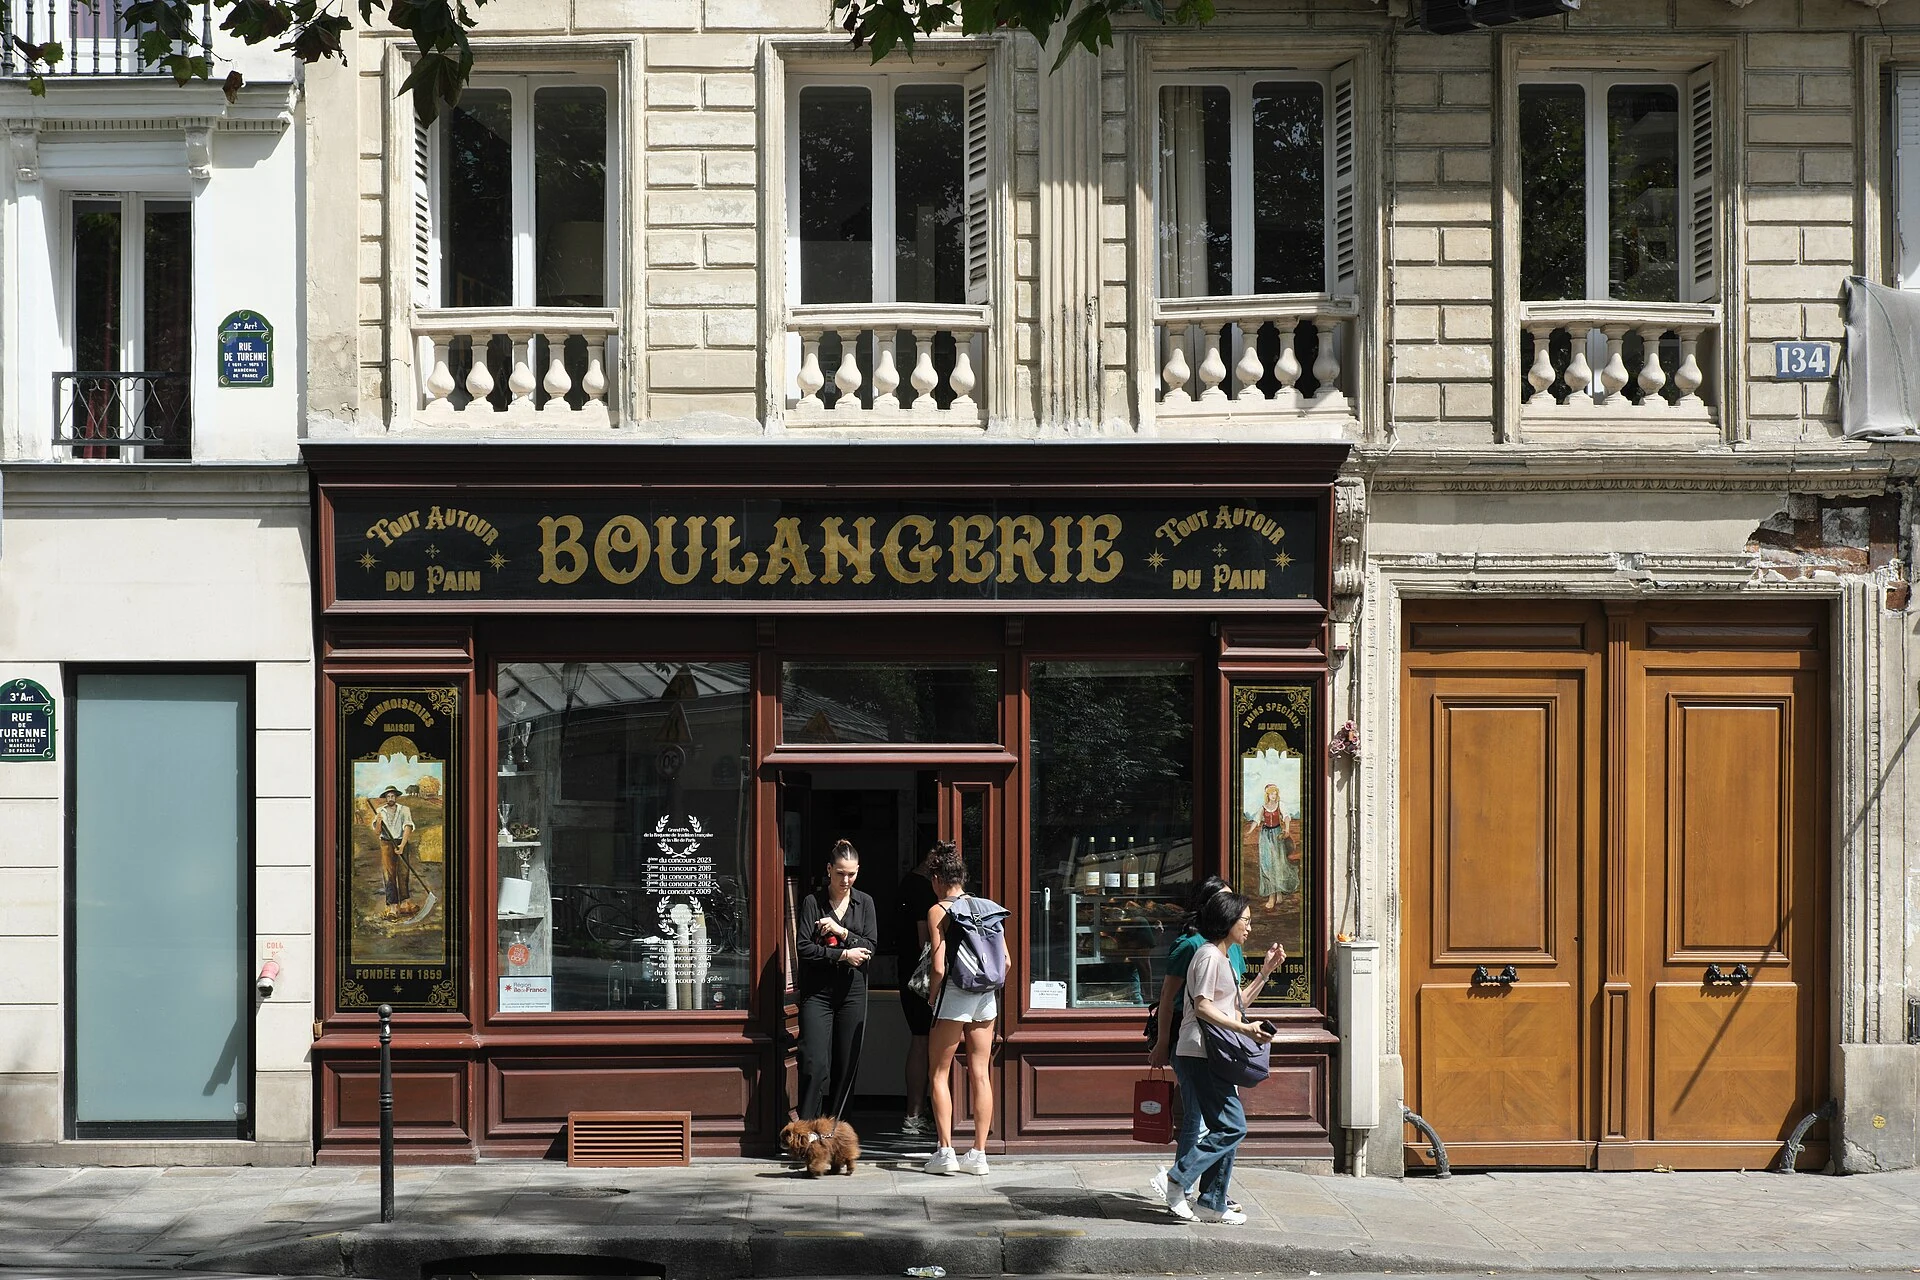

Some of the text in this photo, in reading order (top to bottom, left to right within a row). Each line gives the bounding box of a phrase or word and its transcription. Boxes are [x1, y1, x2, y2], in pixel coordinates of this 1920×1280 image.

[238, 342, 252, 351] RUE
[224, 353, 266, 361] DE TURENNE
[1780, 347, 1825, 372] 134
[537, 513, 1124, 585] BOULANGERIE
[11, 713, 32, 722] RUE
[363, 698, 435, 728] VIENNOISERIES
[1243, 703, 1301, 729] PAINS SPECIAUX
[383, 724, 415, 732] MAISON
[0, 729, 46, 738] TURENNE
[1285, 964, 1303, 973] 1859
[400, 970, 412, 979] EN
[418, 969, 442, 979] 1859
